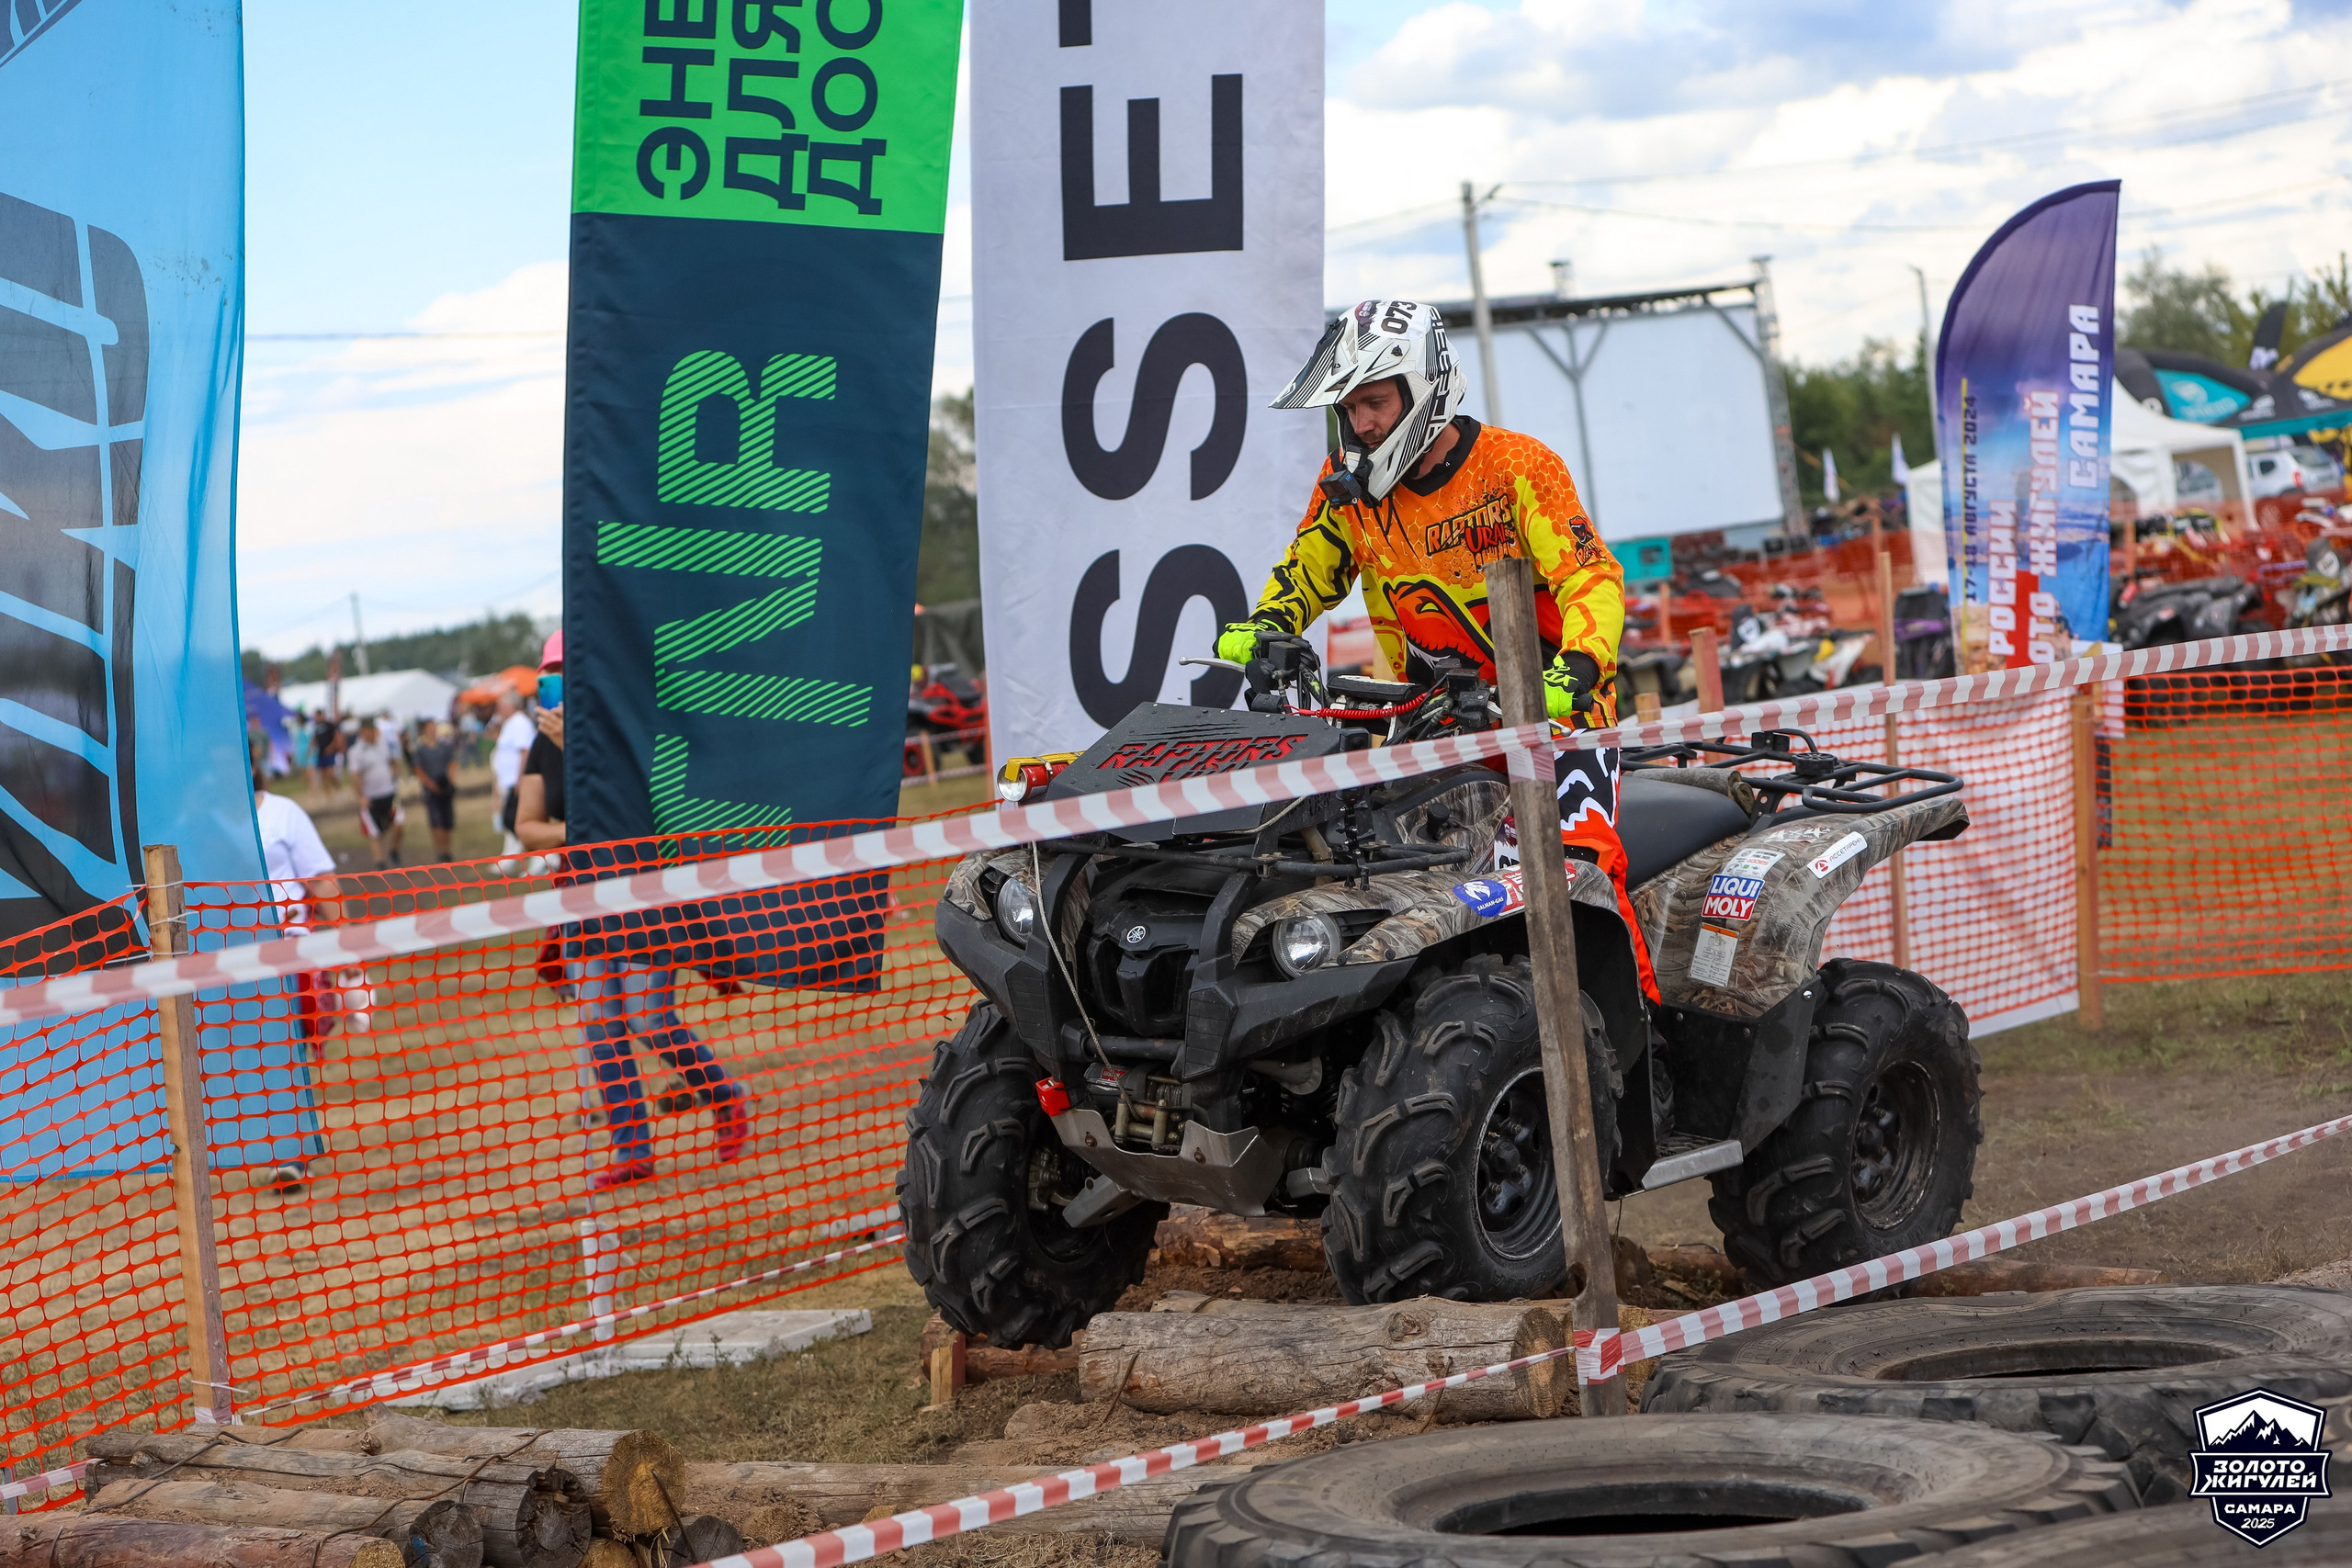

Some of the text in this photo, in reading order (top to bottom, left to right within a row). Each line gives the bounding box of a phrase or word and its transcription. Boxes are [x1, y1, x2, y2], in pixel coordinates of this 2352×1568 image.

[724, 0, 808, 210] ДЛЯ
[1381, 300, 1417, 334] 073
[2069, 304, 2101, 488] САМАРА
[1964, 395, 1978, 602] 17-18 АВГУСТА 2024
[2024, 390, 2059, 577] ЖИГУЛЕЙ
[1427, 494, 1514, 554] RAPTORS
[1464, 524, 1507, 553] URAL
[1988, 500, 2018, 656] РОССИИ
[1096, 733, 1309, 770] RAPTORS
[1476, 896, 1504, 911] SALMAN-GAS
[1704, 897, 1754, 918] MOLY
[1711, 876, 1761, 897] LIQUI
